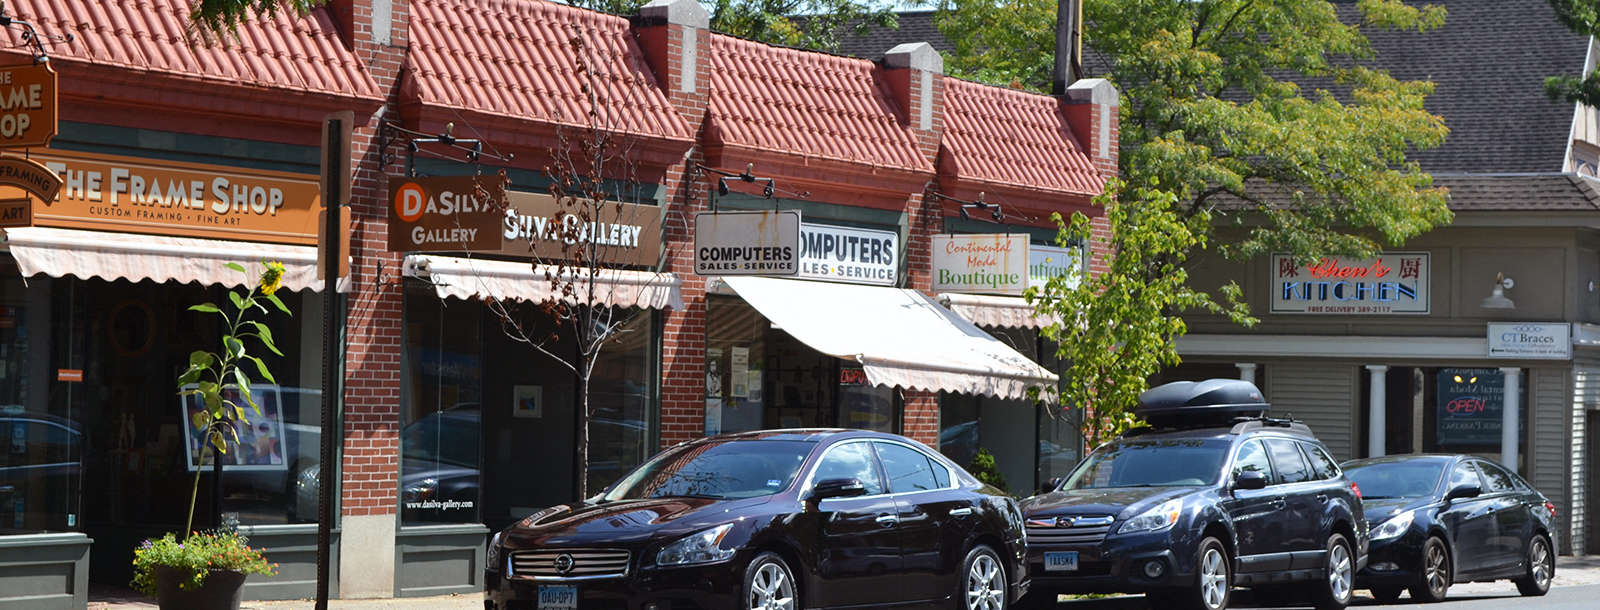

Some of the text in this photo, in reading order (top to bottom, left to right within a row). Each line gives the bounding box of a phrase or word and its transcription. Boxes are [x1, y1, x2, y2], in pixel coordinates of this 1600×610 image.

[0, 113, 30, 137] OP
[0, 165, 50, 191] FRAMING
[46, 161, 284, 215] THE FRAME SHOP
[2, 206, 25, 220] ART
[90, 206, 241, 226] CUSTOM FRAMING FINE ART
[411, 226, 478, 245] GALLERY
[699, 246, 792, 261] COMPUTERS
[800, 230, 893, 266] OMPUTERS
[946, 240, 1012, 255] Continental
[700, 262, 793, 270] SALES SERVICE
[803, 262, 894, 280] LES SERVICE
[967, 255, 997, 268] Moda
[1306, 257, 1391, 278] Chen's
[938, 268, 1019, 288] Boutique
[1282, 281, 1418, 302] KITCHEN
[1447, 399, 1486, 412] OPEN
[406, 499, 474, 511] www.dasilva-gallery.com
